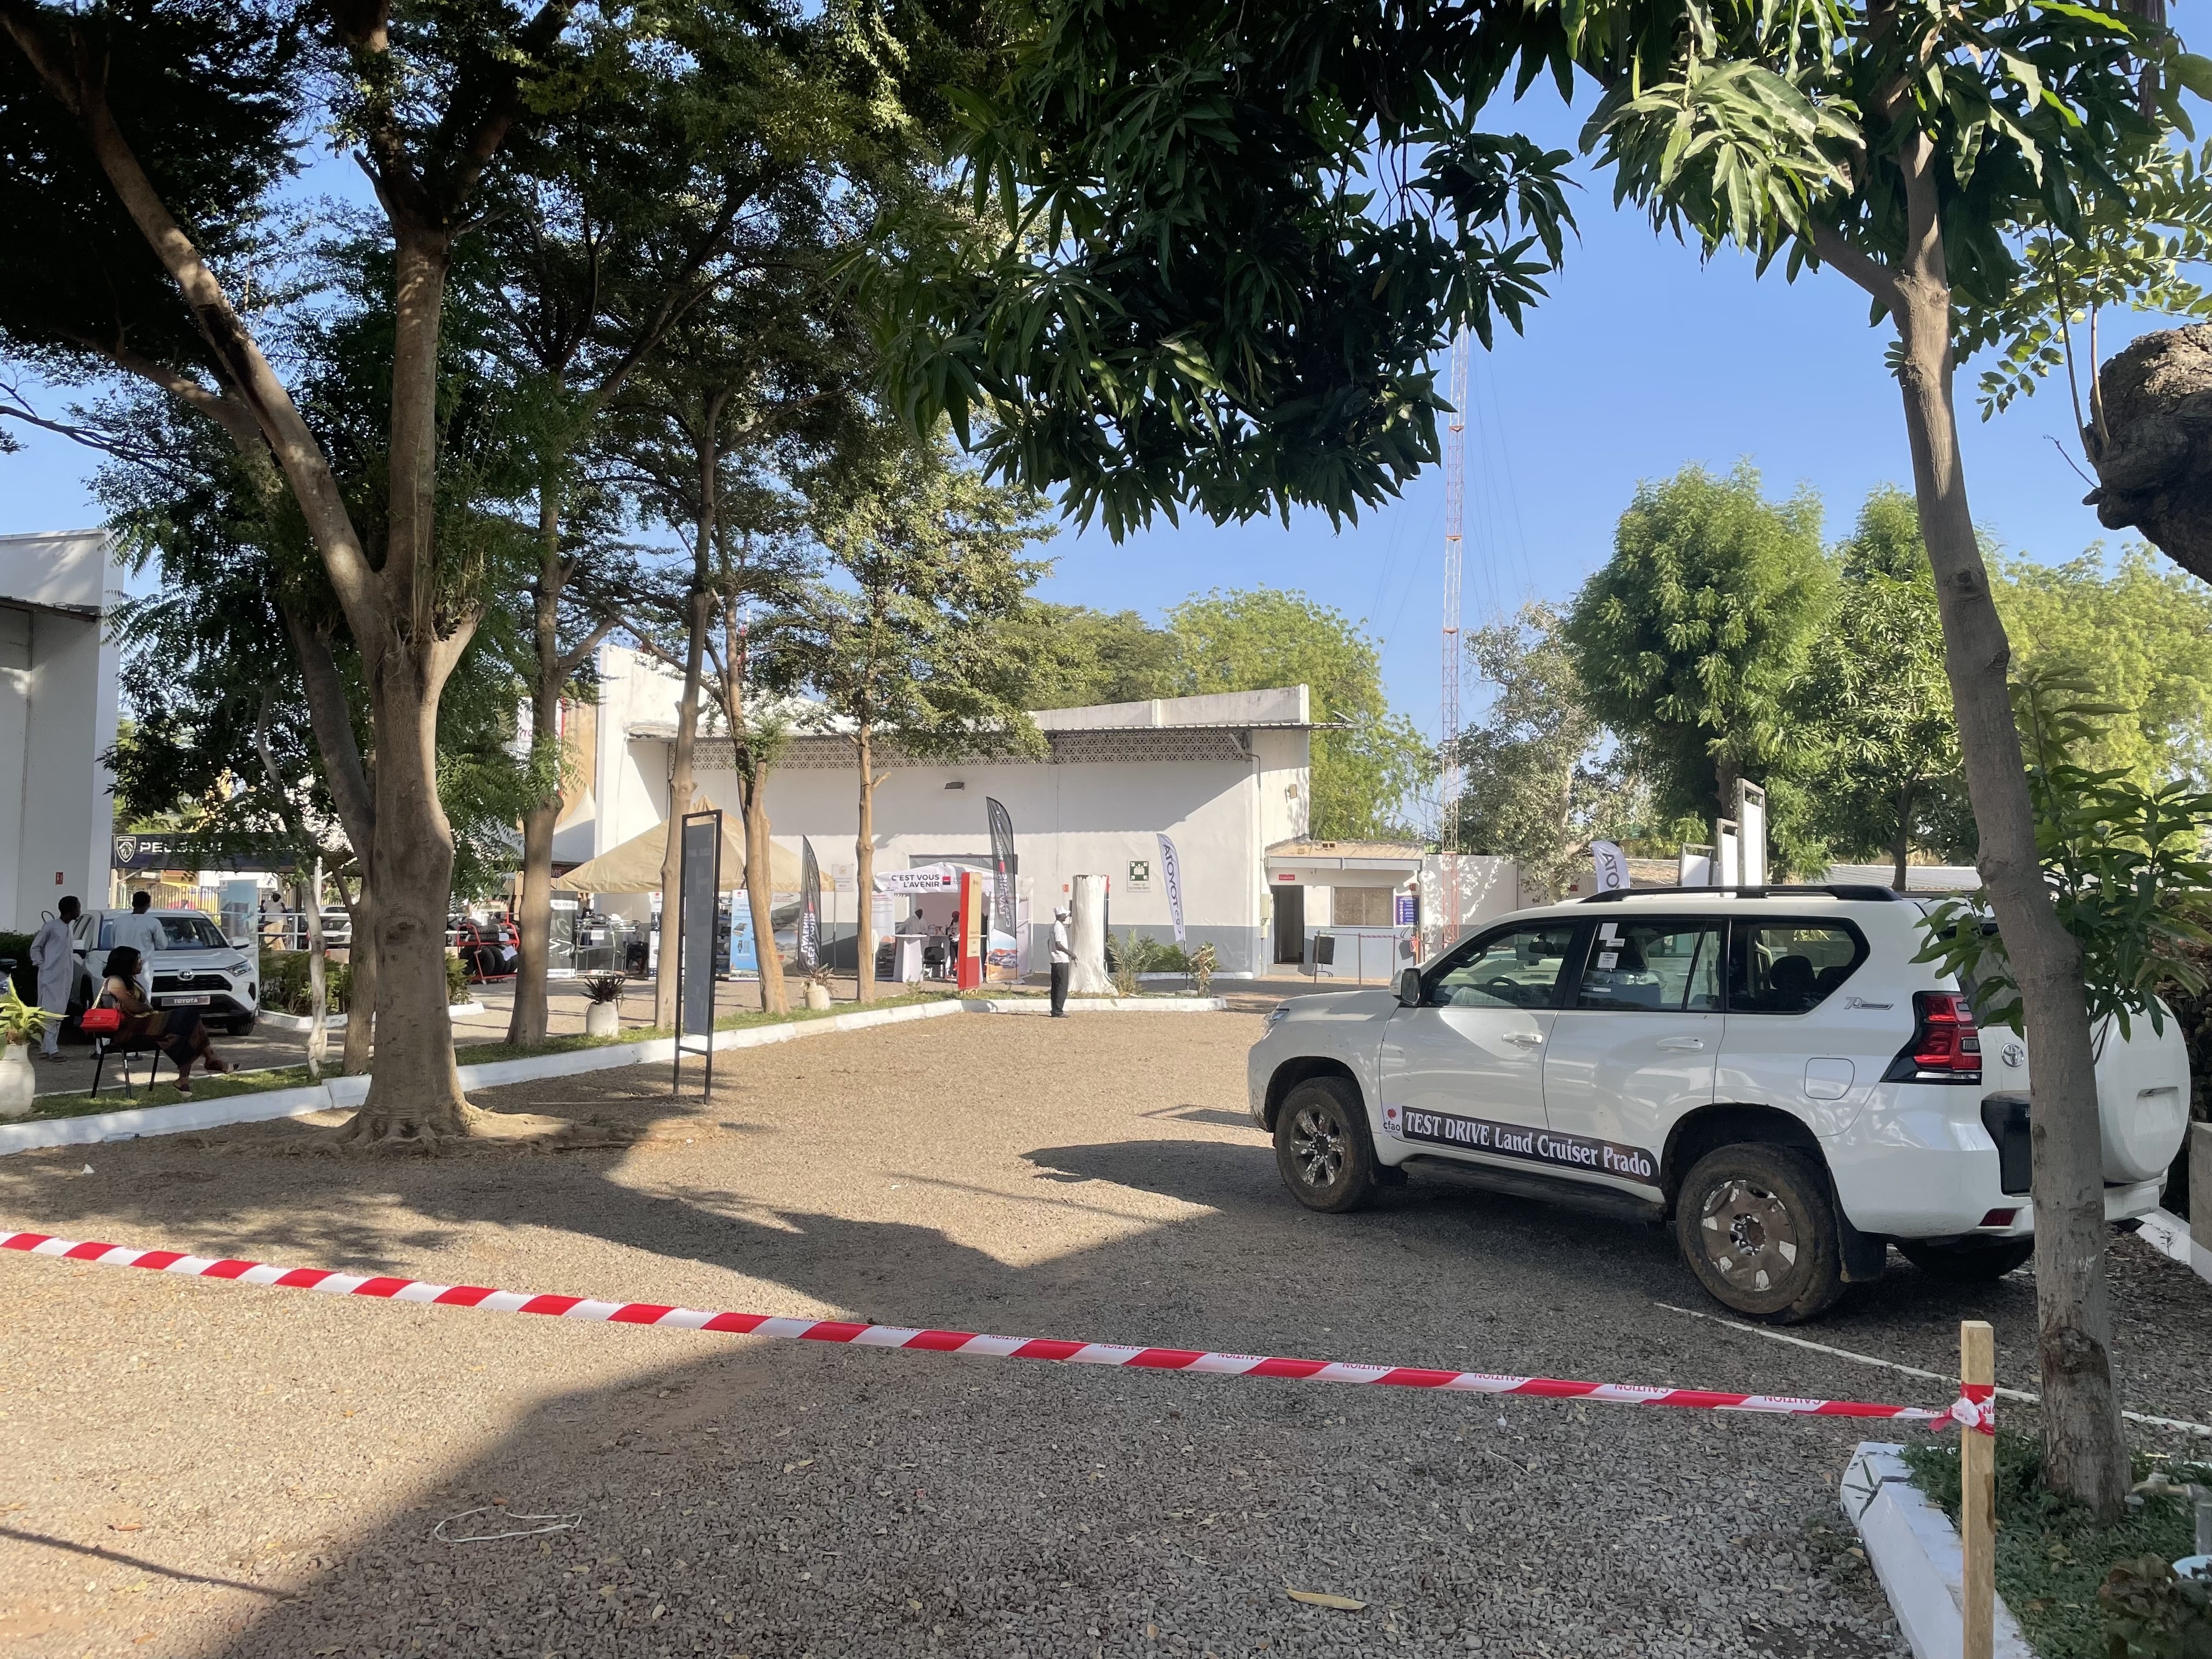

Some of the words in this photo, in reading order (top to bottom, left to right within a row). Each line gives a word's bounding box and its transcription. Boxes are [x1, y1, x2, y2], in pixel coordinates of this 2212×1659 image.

[1383, 1120, 1401, 1131] cfao
[1405, 1111, 1442, 1137] TEST
[1444, 1118, 1489, 1146] DRIVE
[1495, 1127, 1533, 1154] Land
[1537, 1135, 1598, 1166] Cruiser
[1603, 1146, 1651, 1177] Prado
